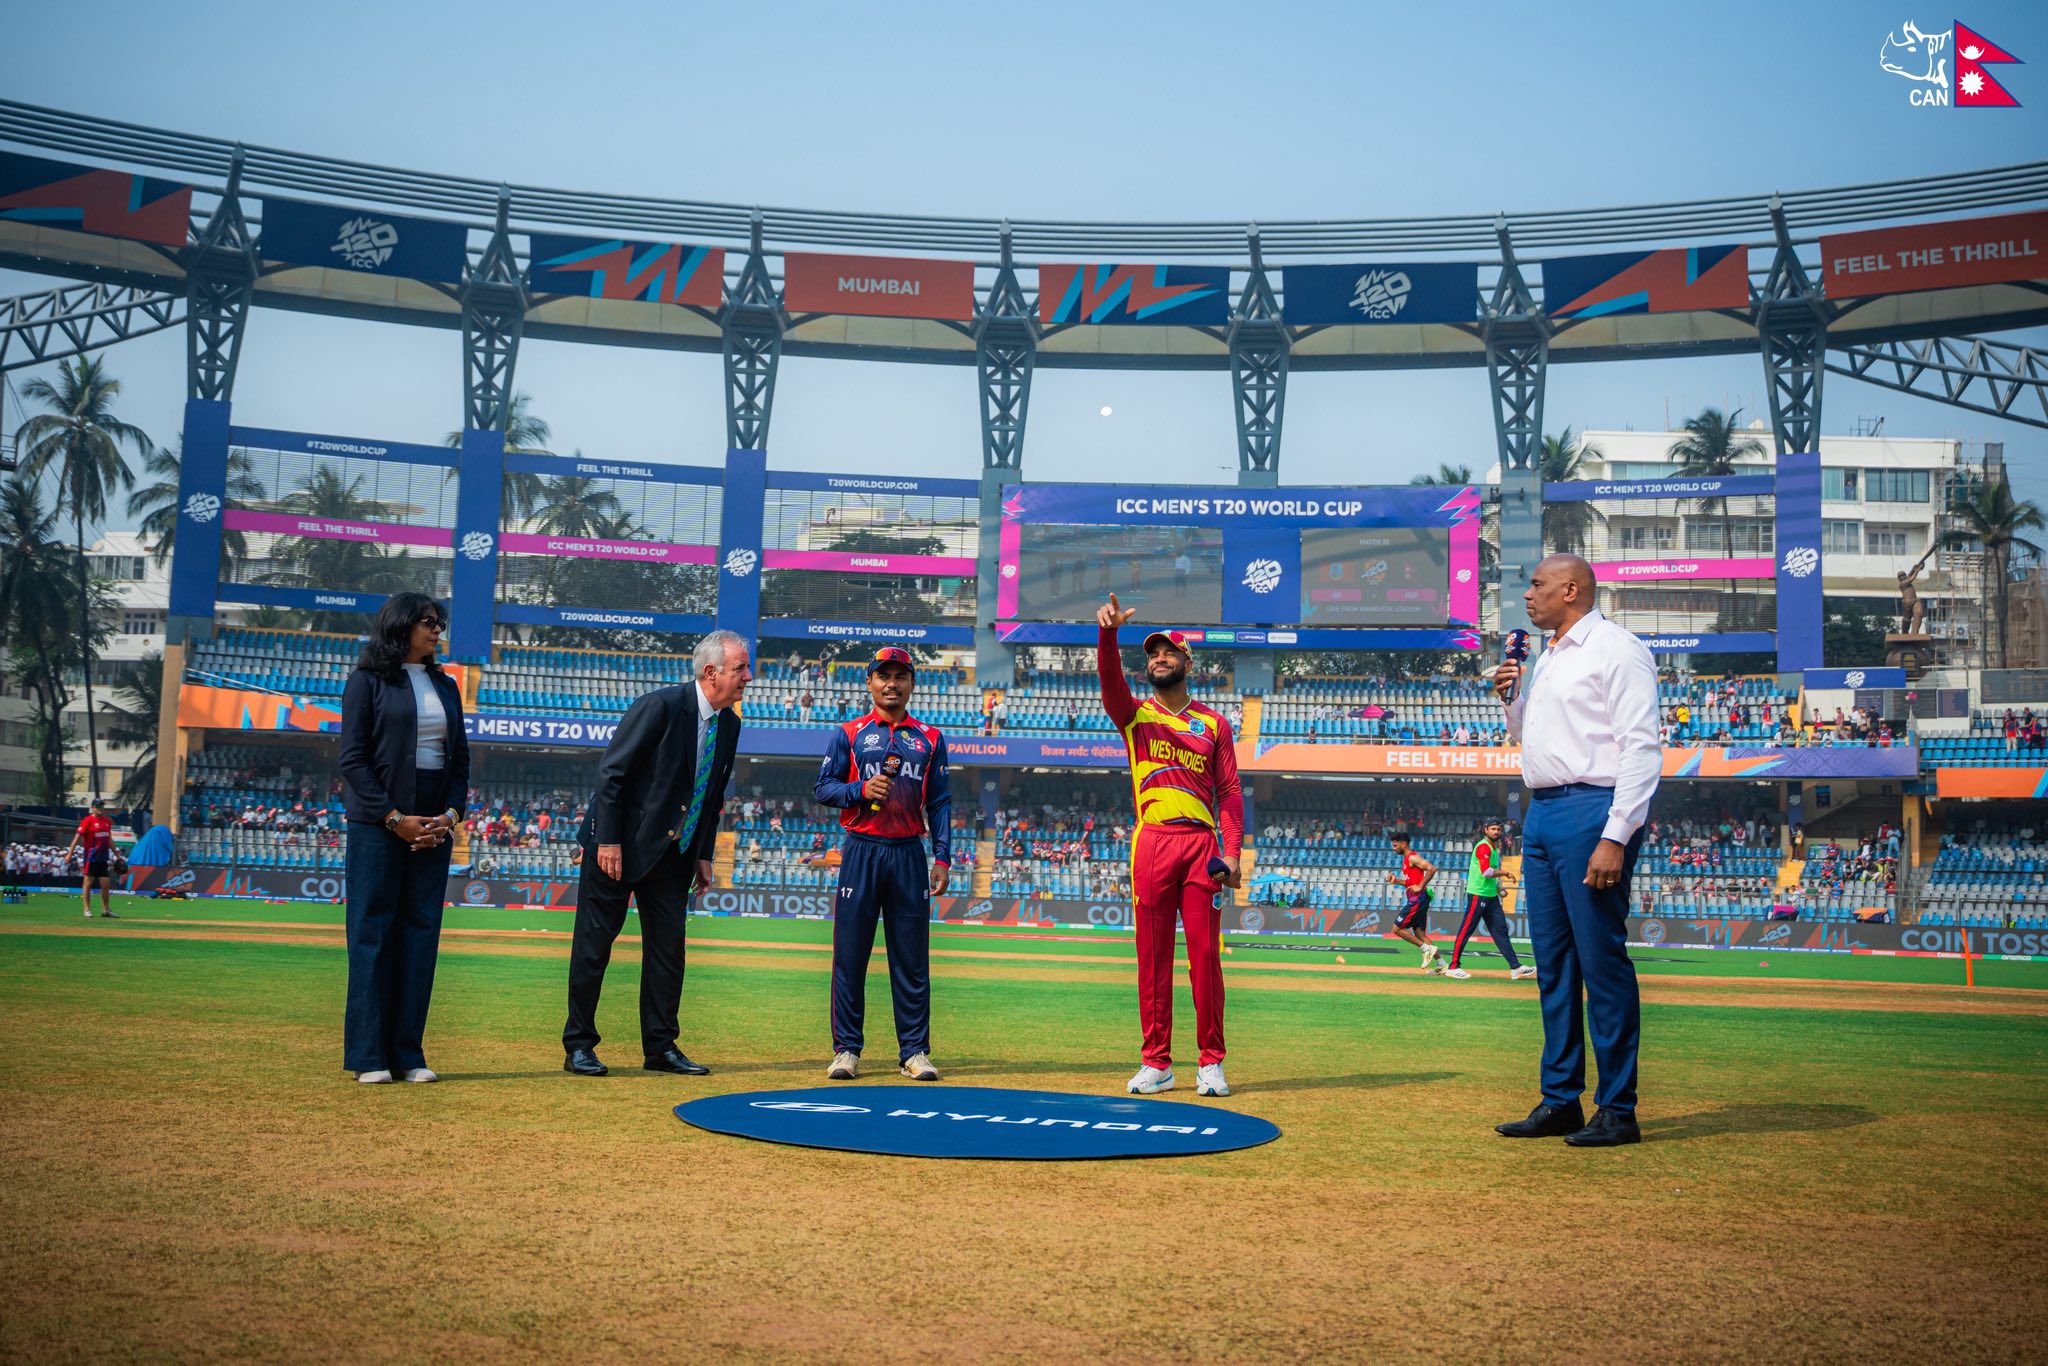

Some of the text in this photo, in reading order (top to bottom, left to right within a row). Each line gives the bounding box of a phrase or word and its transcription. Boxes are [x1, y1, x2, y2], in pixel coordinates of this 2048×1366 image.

[352, 258, 374, 270] ICC
[1833, 239, 2038, 275] FEEL THE THRILL
[838, 277, 920, 295] MUMBAI
[1369, 309, 1390, 319] ICC
[306, 440, 388, 456] #T20WORLDCUP
[577, 463, 654, 477] FEEL THE THRILL
[828, 478, 919, 490] T20WORLDCUP.COM
[1595, 482, 1721, 494] ICC MEN'S T20 WORLD CUP
[1116, 499, 1363, 517] ICC MEN'S T20 WORLD CUP
[298, 521, 380, 537] FEEL THE THRILL
[547, 542, 668, 557] ICC MEN'S T20 WORLD CUP
[850, 557, 888, 567] MUMBAI
[1617, 563, 1699, 575] #T20WORLDCUP
[1255, 586, 1269, 594] ICC
[315, 595, 356, 606] MUMBAI
[560, 611, 653, 625] T20WORLDCUP.COM
[808, 625, 927, 638] ICC MEN'S T20 WORLD CUP
[1641, 639, 1700, 648] WORLDCUP
[478, 719, 544, 738] MEN'S
[545, 722, 583, 740] T20
[948, 743, 1007, 755] PAVILION
[1150, 738, 1176, 760] WEST
[1386, 751, 1521, 769] FEEL THE THR
[865, 761, 923, 781] NAL
[301, 877, 347, 898] COI
[840, 886, 853, 899] 17
[703, 892, 831, 915] COIN TOSS
[1087, 905, 1135, 926] COI
[1901, 929, 1974, 953] COIN
[887, 1109, 1219, 1135] HYUNDAI
